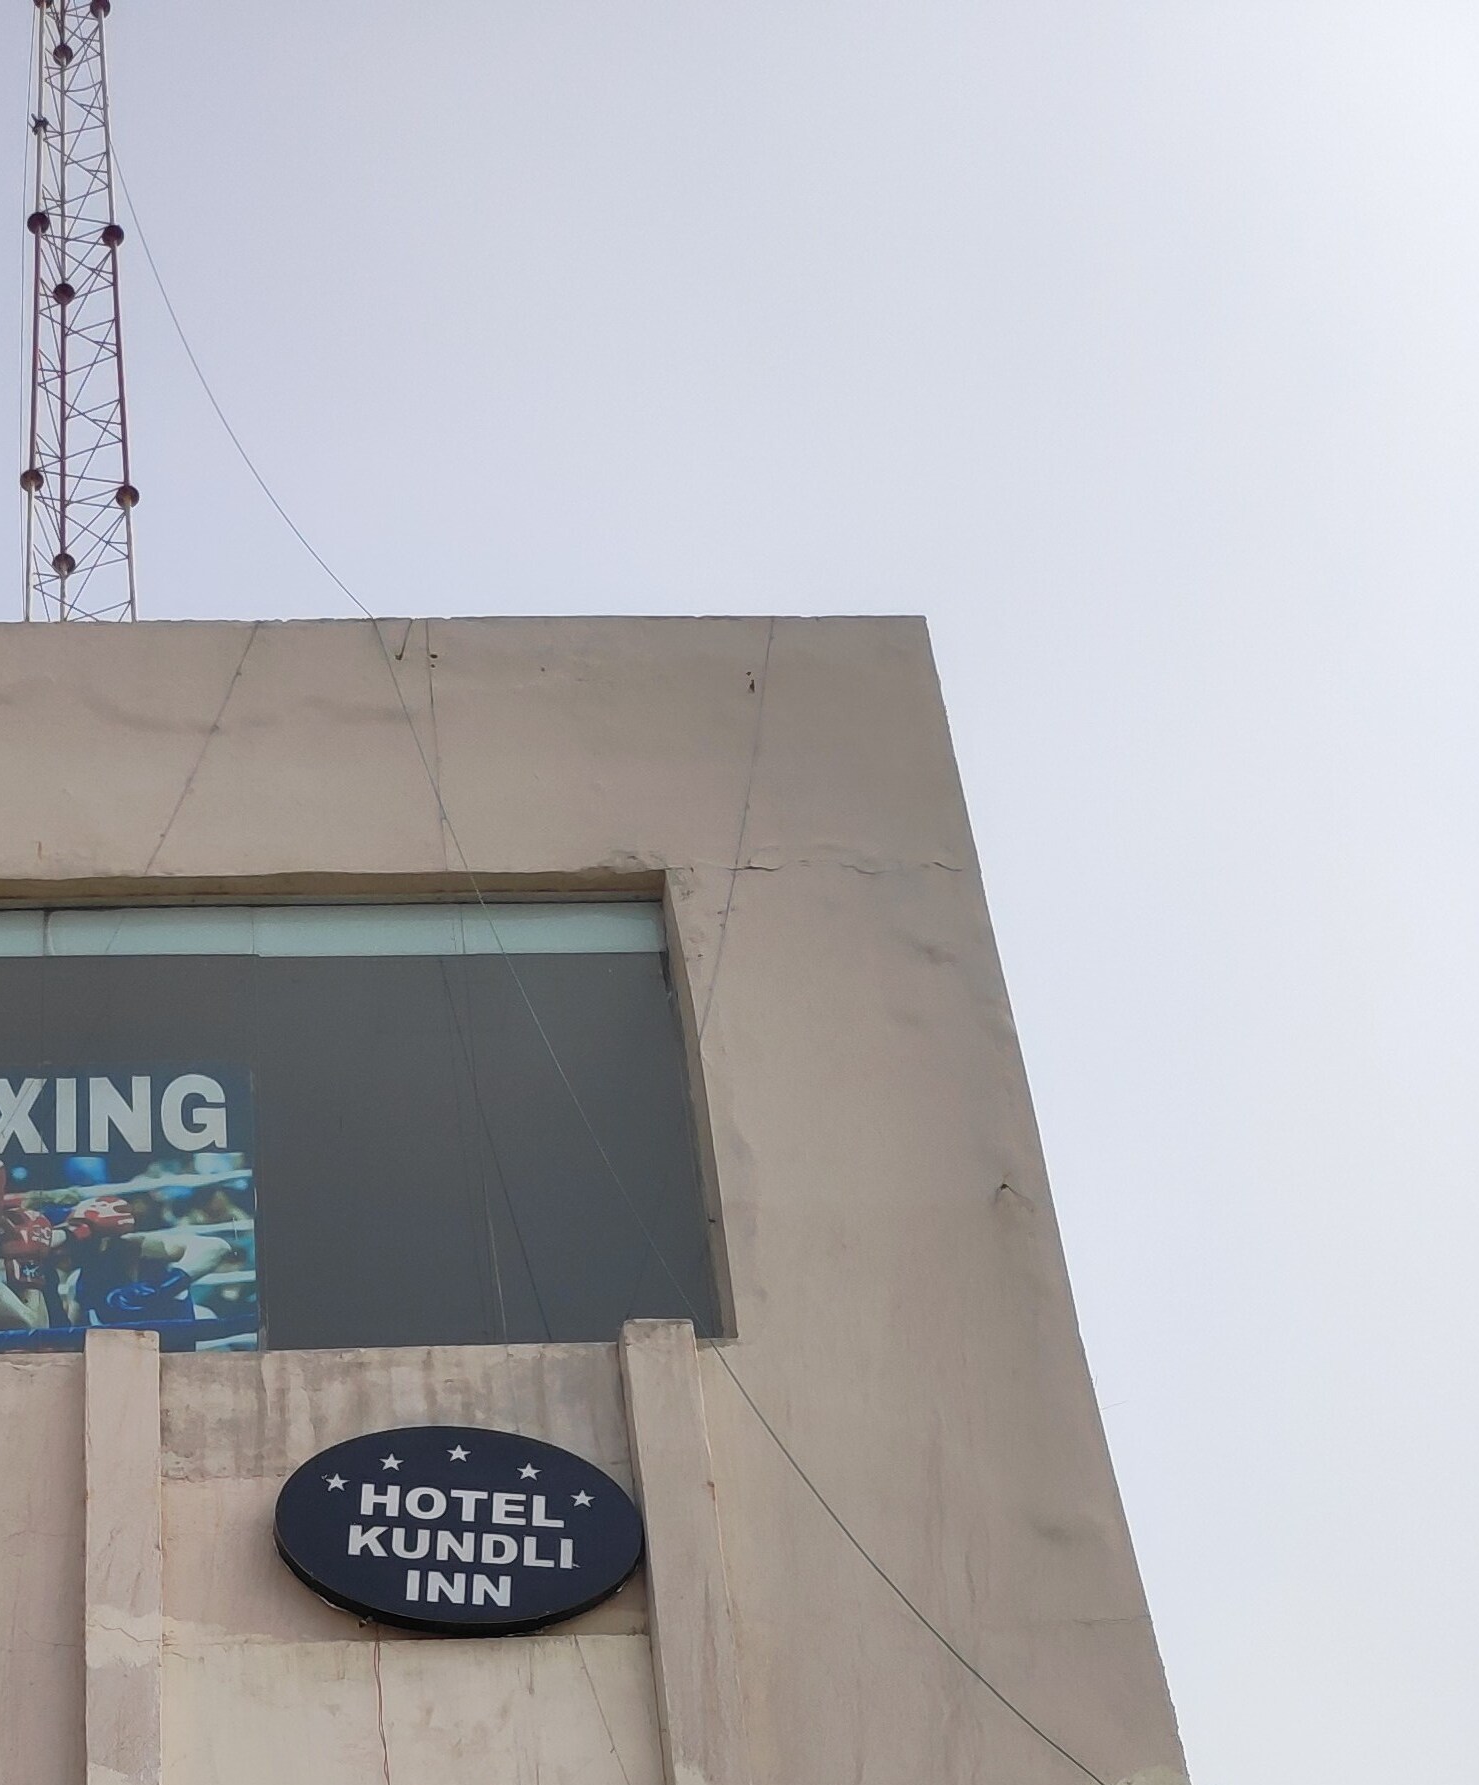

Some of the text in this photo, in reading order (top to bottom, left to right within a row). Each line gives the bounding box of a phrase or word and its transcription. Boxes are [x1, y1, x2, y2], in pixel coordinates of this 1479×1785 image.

[359, 1483, 565, 1528] HOTEL
[347, 1524, 575, 1569] KUNDLI
[405, 1569, 512, 1607] INN
